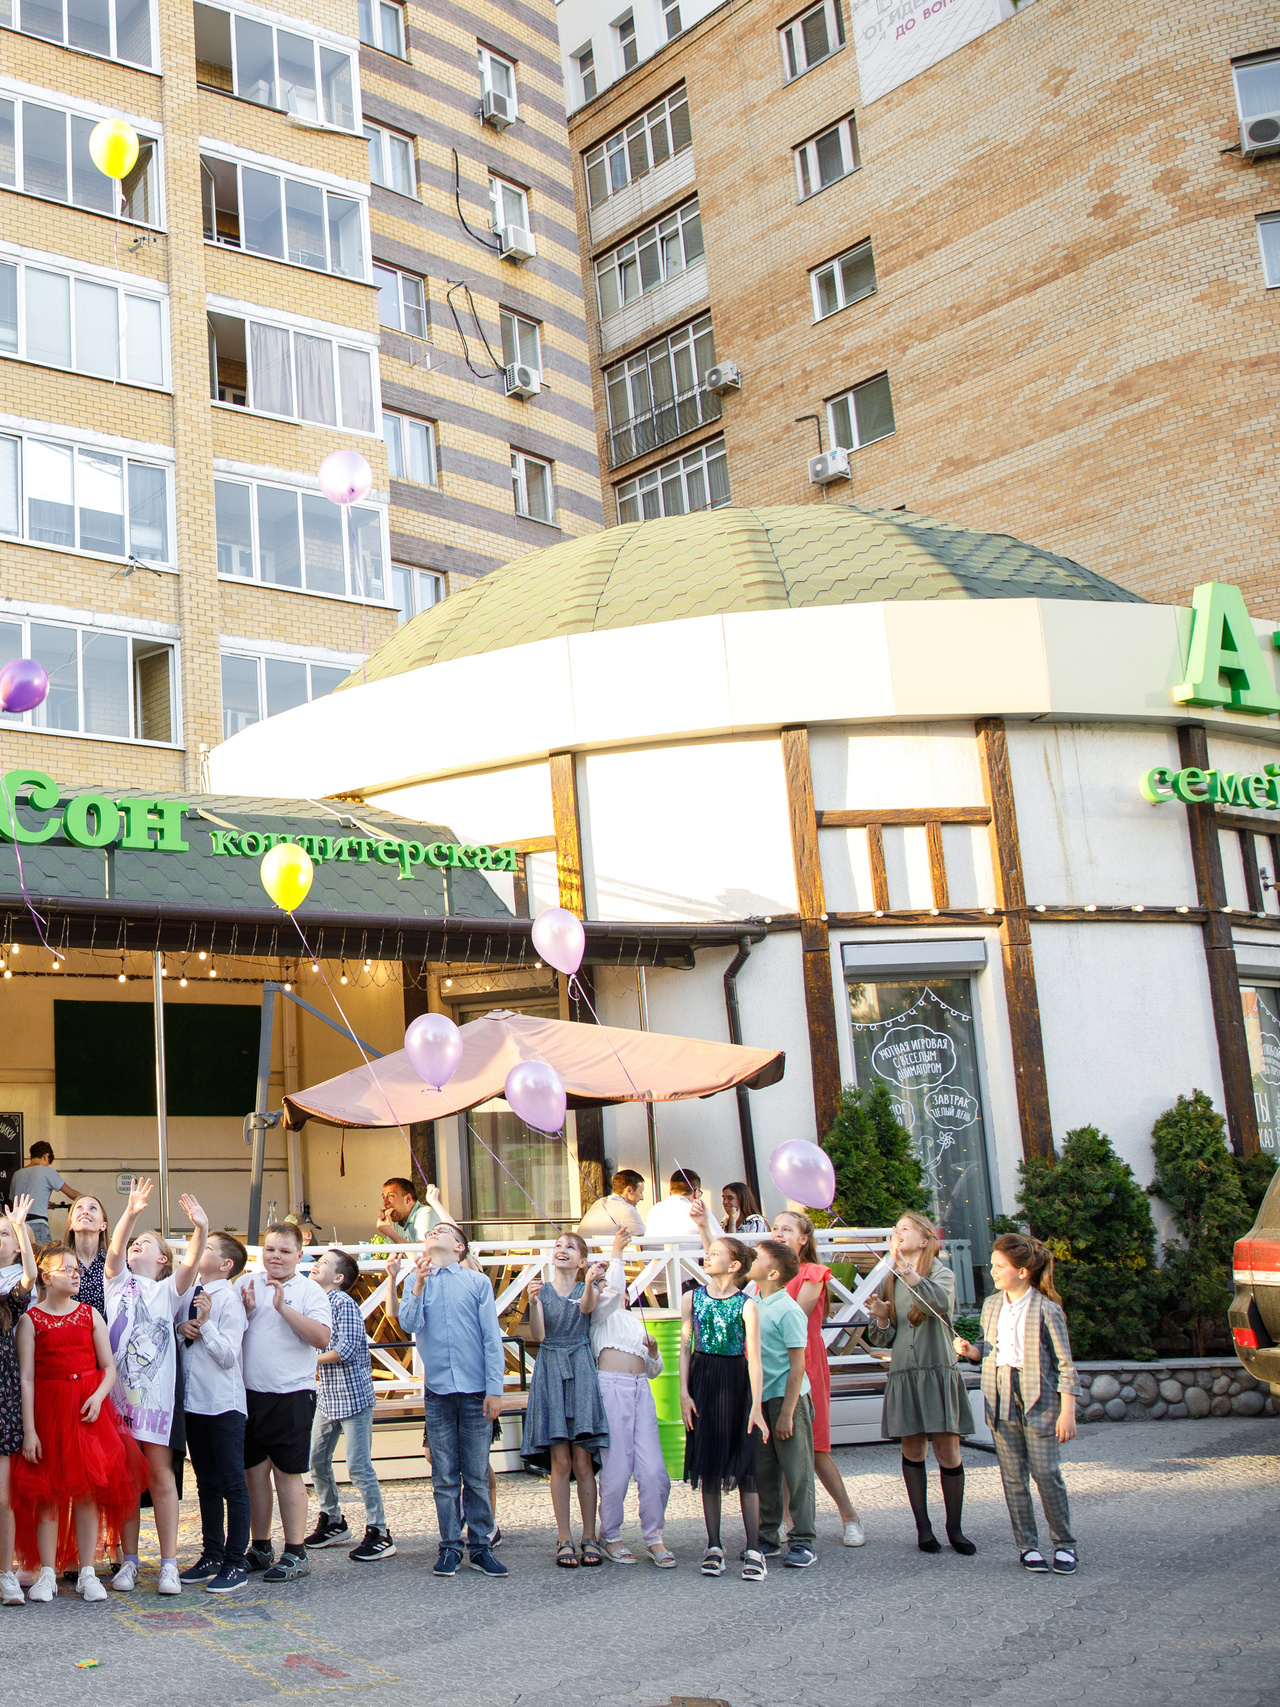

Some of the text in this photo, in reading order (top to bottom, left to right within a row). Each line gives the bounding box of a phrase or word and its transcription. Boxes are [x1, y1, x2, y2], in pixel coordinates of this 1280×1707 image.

[896, 18, 916, 40] ДО
[878, 1038, 948, 1060] УЮТНАЯ ИГРОВАЯ
[893, 1050, 937, 1068] С ВЕСЕЛЫМ
[897, 1062, 942, 1080] АНИМАТОРОМ
[932, 1094, 971, 1109] ЗАВТРАК
[931, 1105, 971, 1122] ЦЕЛЫЙ ДЕНЬ
